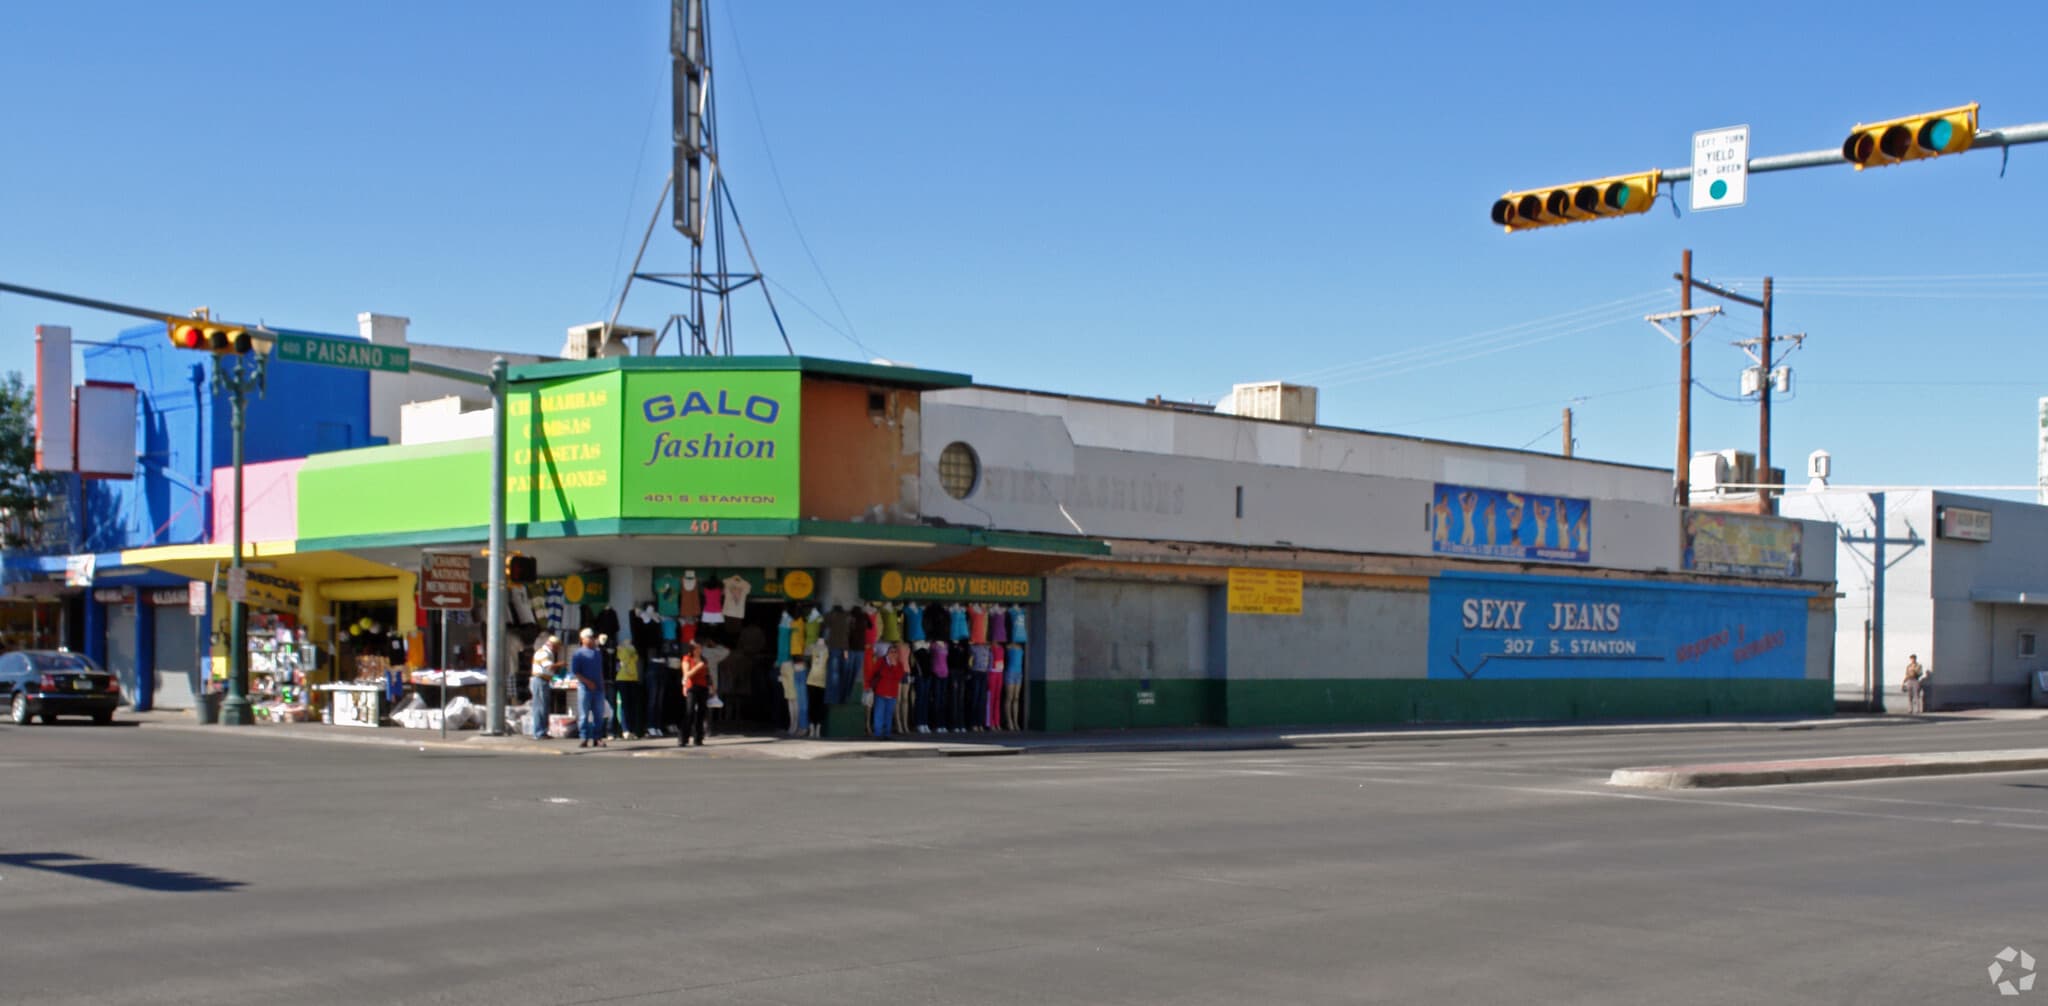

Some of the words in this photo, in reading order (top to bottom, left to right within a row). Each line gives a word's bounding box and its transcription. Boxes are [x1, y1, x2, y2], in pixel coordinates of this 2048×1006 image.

[1696, 137, 1716, 149] LEFT
[1725, 134, 1744, 144] TURN
[1706, 148, 1735, 163] YIELD
[1697, 168, 1708, 176] ON
[1716, 163, 1741, 174] GREEN
[305, 340, 383, 367] PAISANO
[642, 390, 780, 424] GALO
[643, 431, 776, 467] fashion
[643, 494, 673, 503] 401
[698, 494, 776, 504] STANTON
[690, 519, 719, 533] 401
[958, 578, 967, 595] Y
[969, 578, 1030, 597] MENUDEO
[1462, 598, 1526, 631] SEXY
[1548, 601, 1621, 632] JEANS
[1503, 639, 1534, 654] 307
[1570, 639, 1637, 654] STANTON
